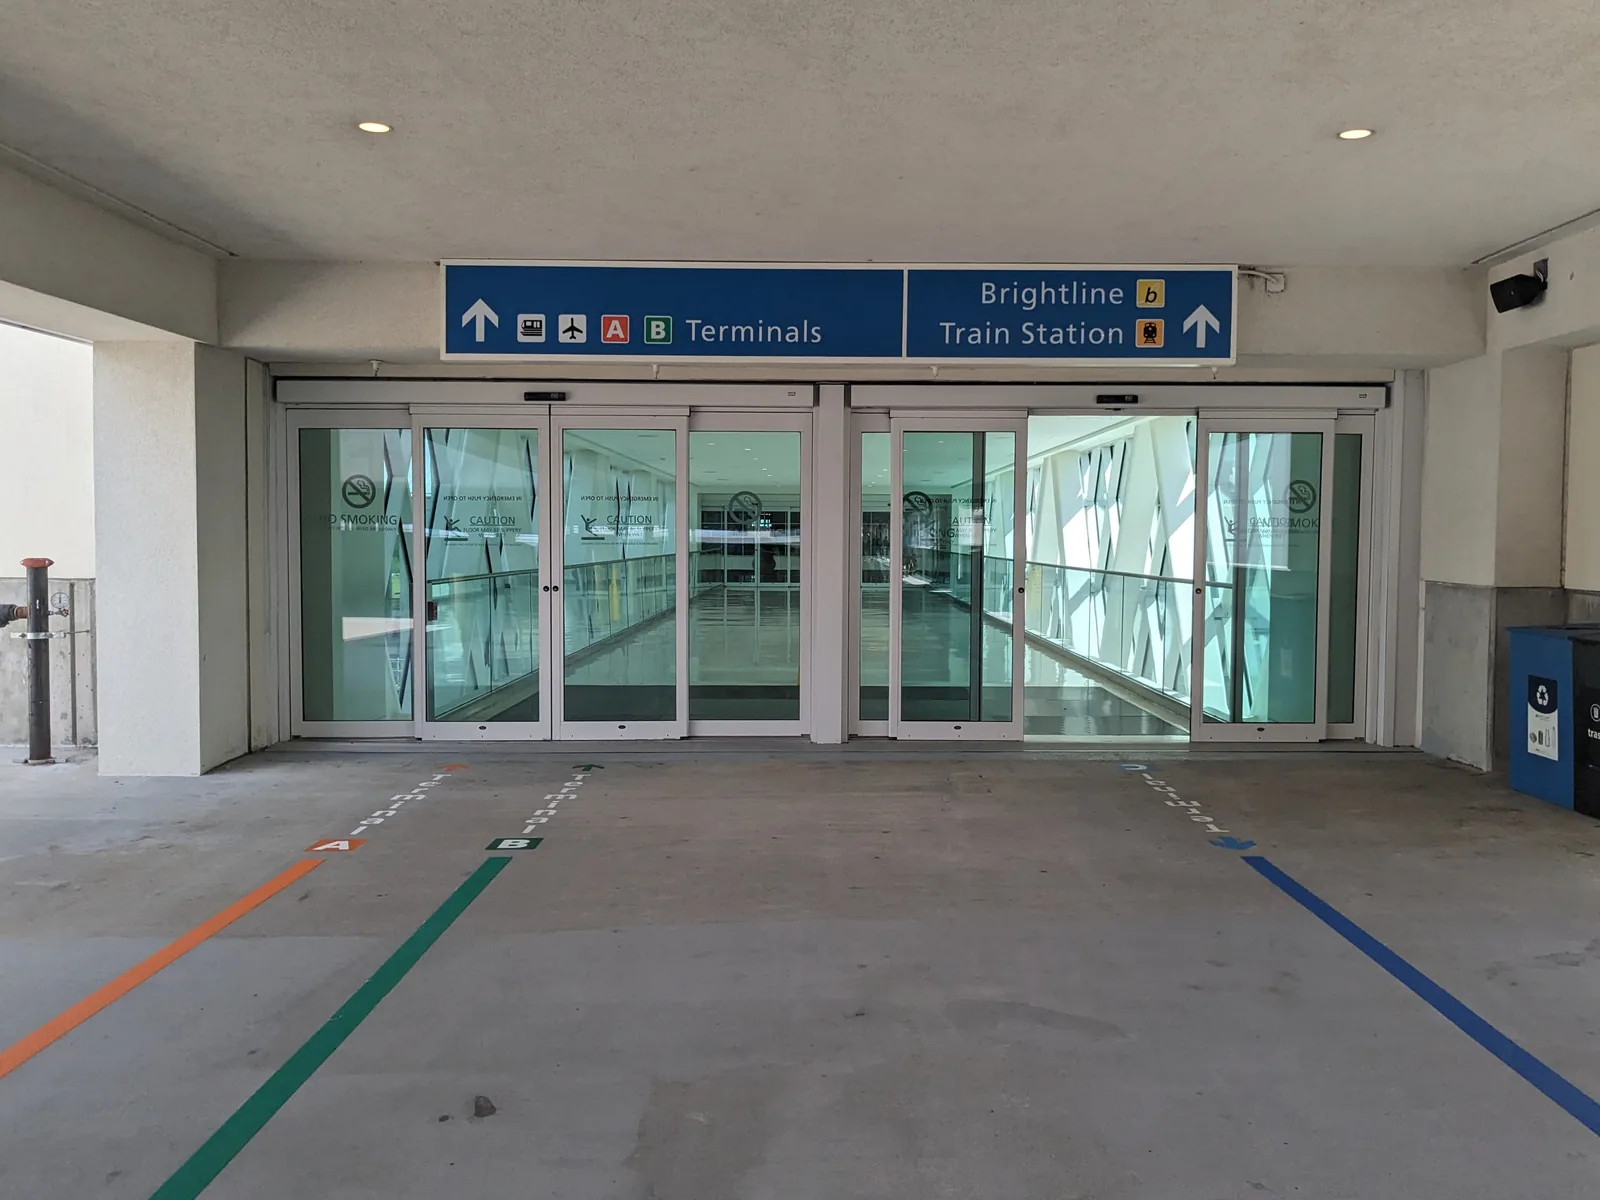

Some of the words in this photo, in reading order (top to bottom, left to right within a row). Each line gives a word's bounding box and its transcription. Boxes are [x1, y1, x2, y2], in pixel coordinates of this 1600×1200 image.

[981, 280, 1124, 311] Brightline
[1144, 286, 1158, 304] b
[605, 320, 625, 339] A
[650, 320, 666, 339] B
[686, 318, 822, 344] Terminals
[939, 321, 1010, 345] Train
[1021, 321, 1124, 345] Station
[340, 514, 398, 525] SMOKING
[469, 515, 516, 525] CAUTION
[606, 514, 652, 524] CAUTION
[350, 773, 451, 835] Terminal
[521, 773, 591, 834] Terminal
[312, 840, 349, 850] A
[496, 839, 529, 849] B
